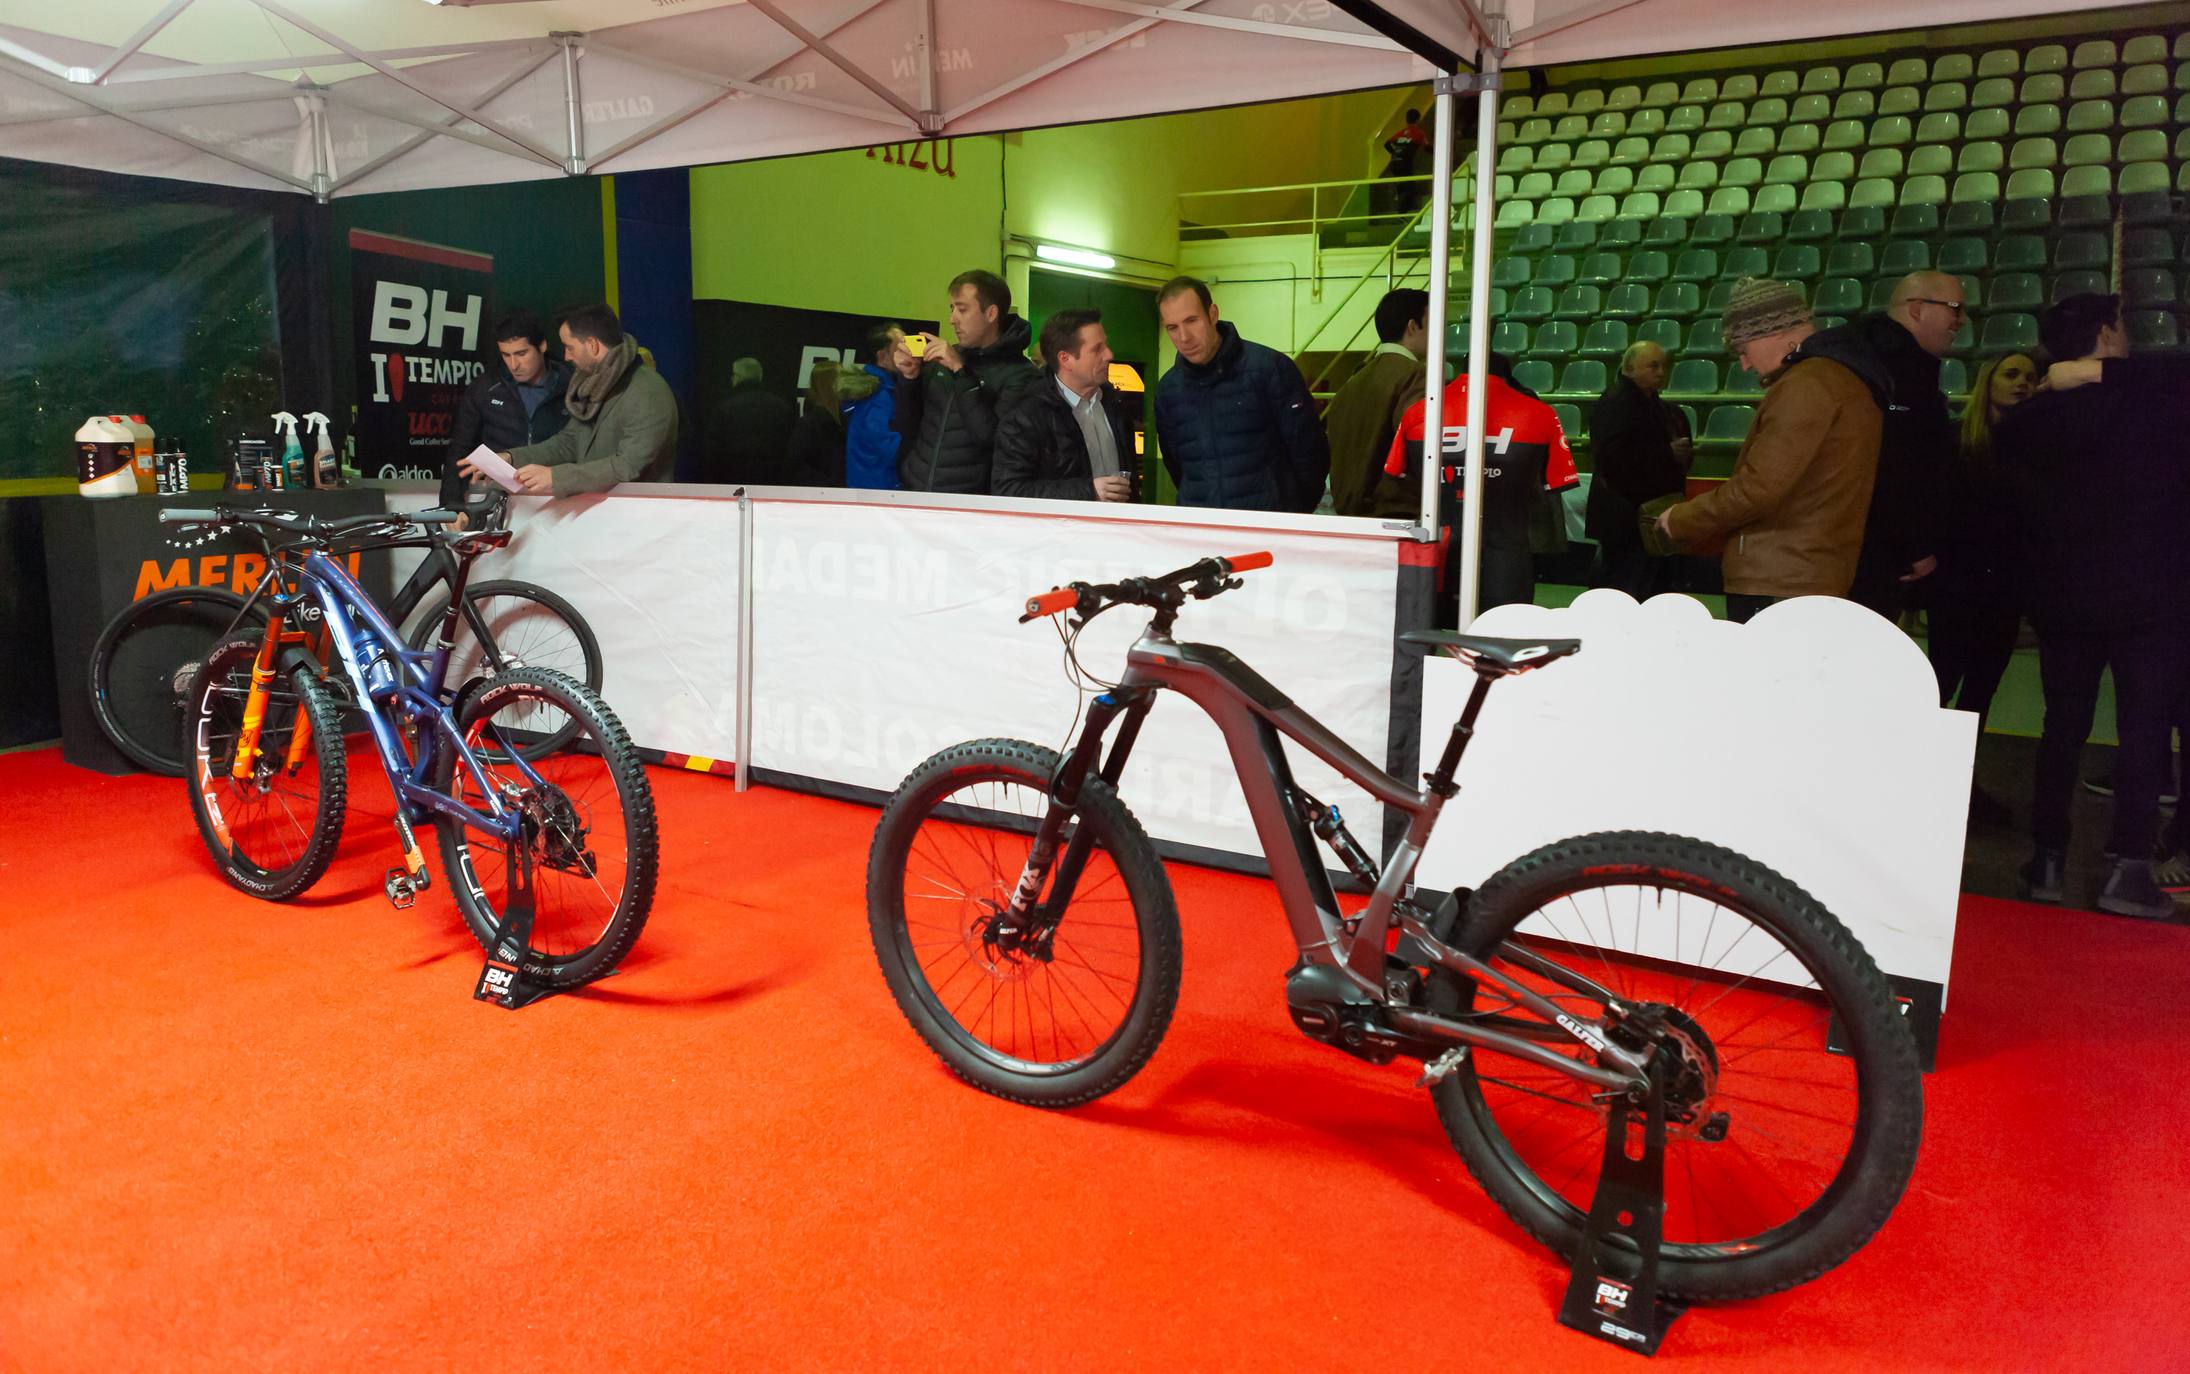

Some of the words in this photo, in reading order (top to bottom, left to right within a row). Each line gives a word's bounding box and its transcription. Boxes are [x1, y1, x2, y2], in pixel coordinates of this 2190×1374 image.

[370, 280, 482, 351] BH
[480, 685, 507, 704] ROCK
[484, 967, 514, 988] BH
[1555, 1014, 1606, 1053] GALFER
[1596, 1283, 1629, 1301] BH
